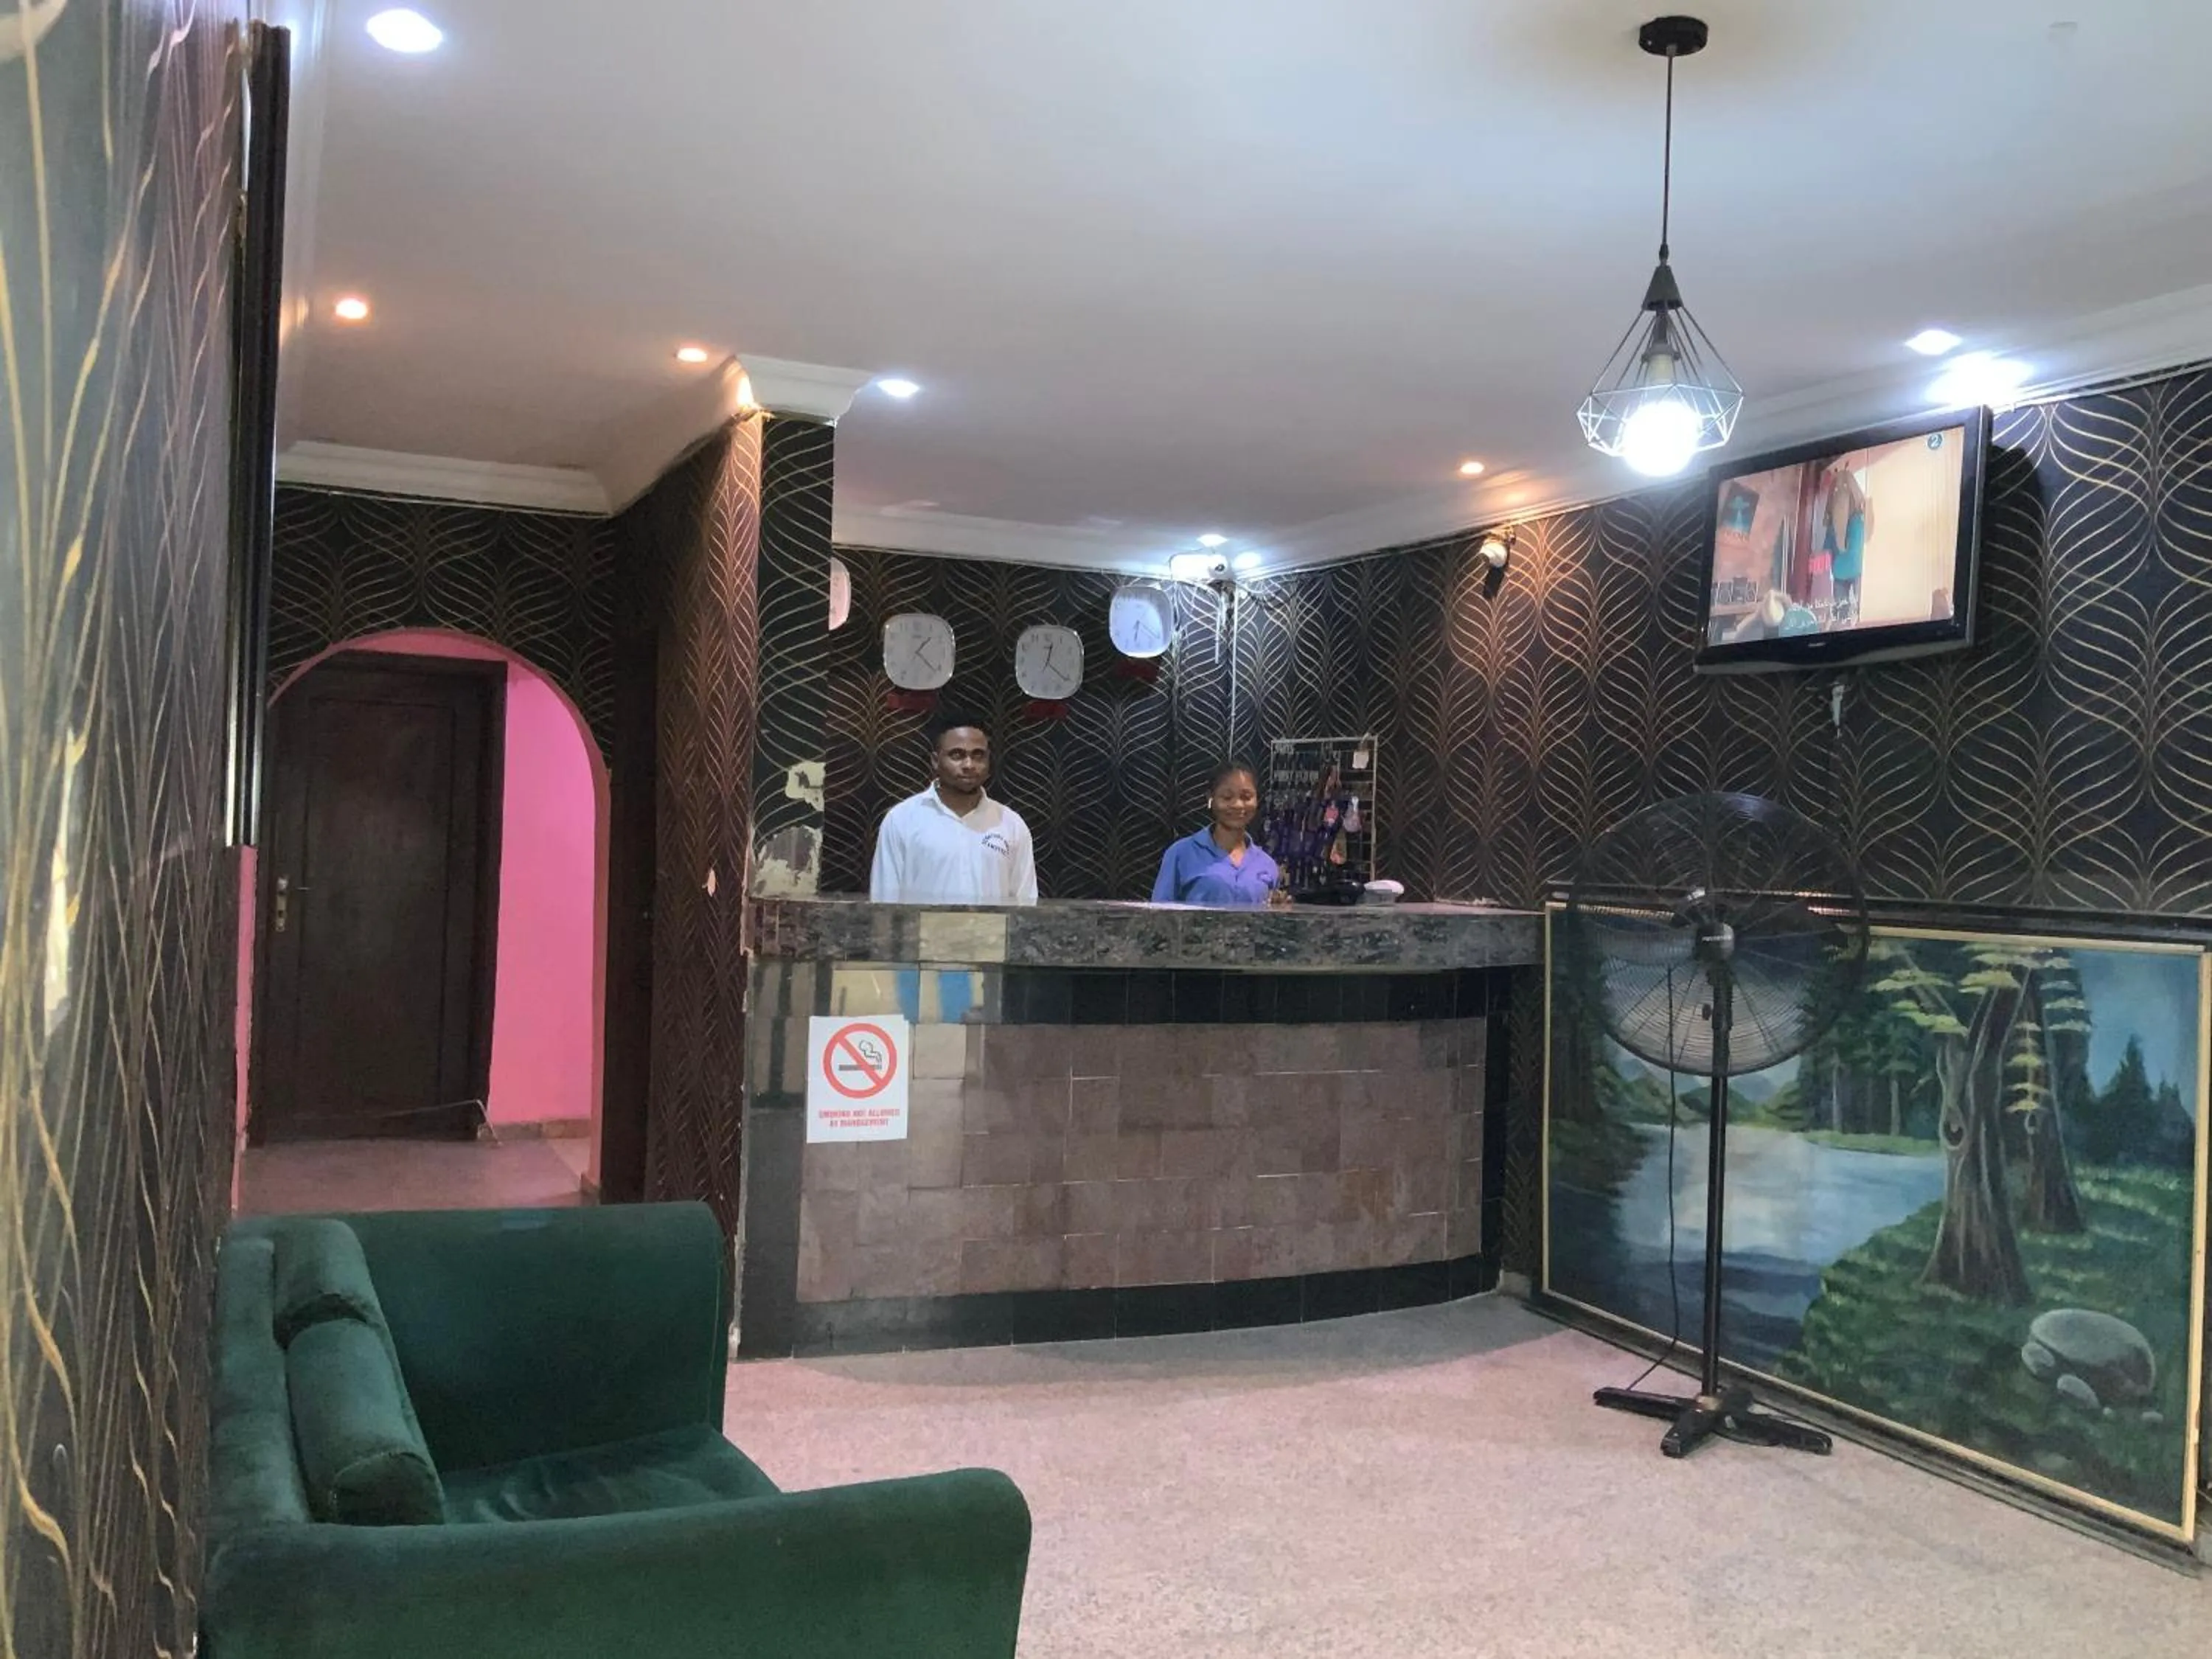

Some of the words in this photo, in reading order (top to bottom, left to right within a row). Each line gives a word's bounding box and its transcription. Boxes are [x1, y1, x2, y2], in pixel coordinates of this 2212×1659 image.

[819, 1110, 851, 1118] SMOKING
[868, 1108, 900, 1117] ALLOWED
[840, 1119, 888, 1127] MANAGEMENT
